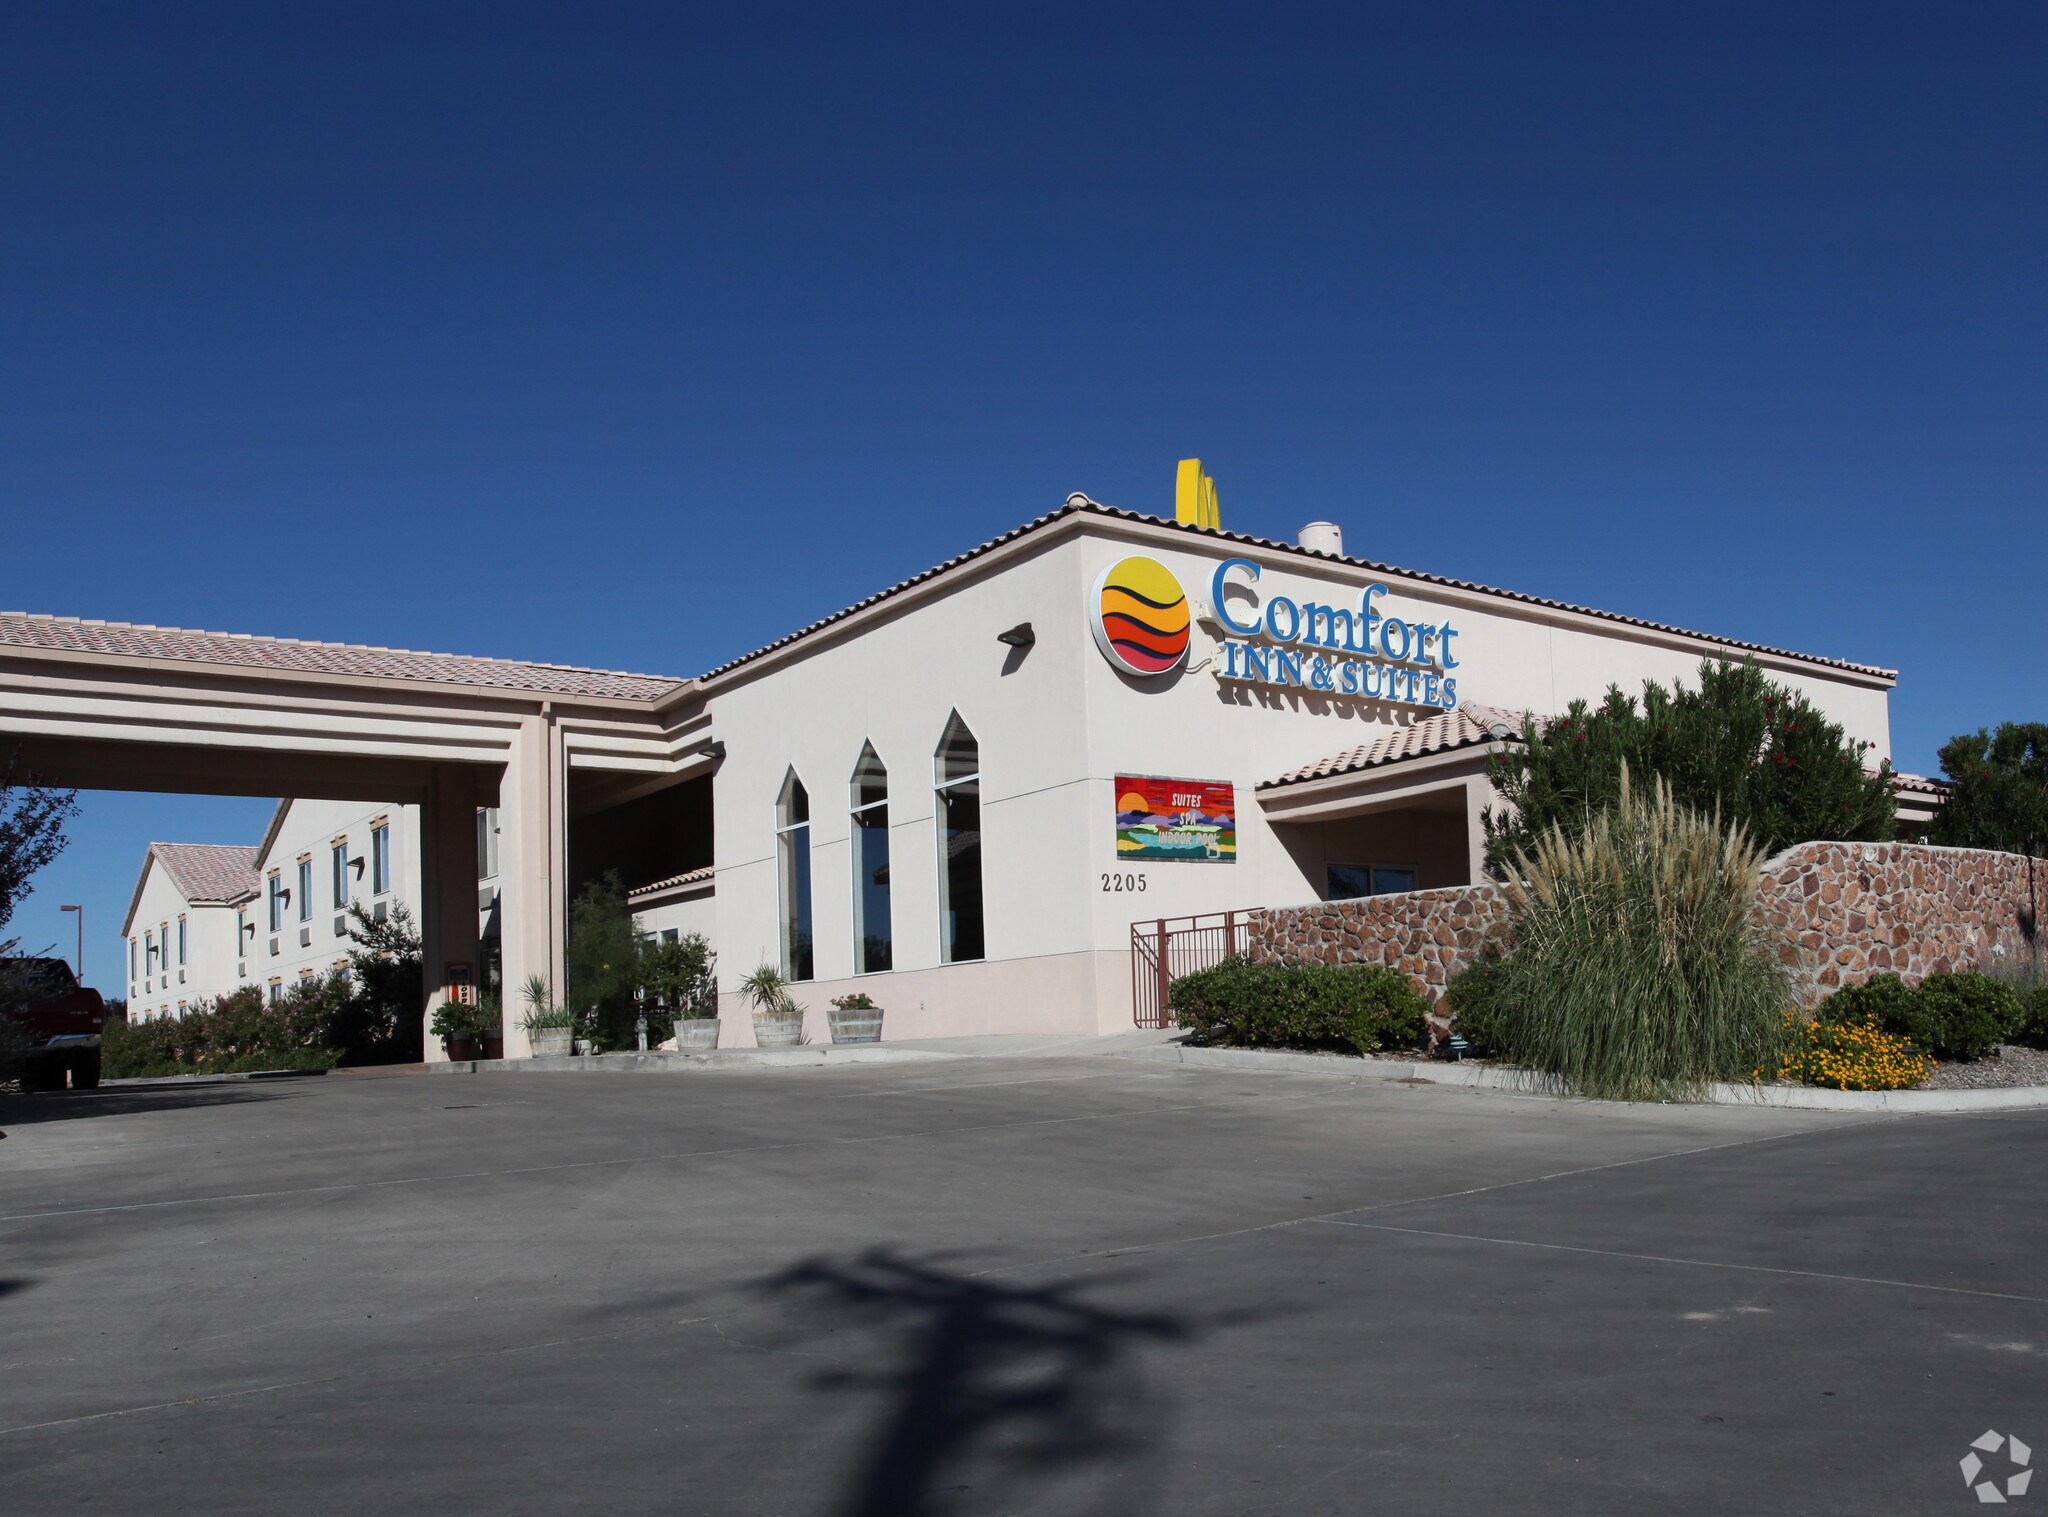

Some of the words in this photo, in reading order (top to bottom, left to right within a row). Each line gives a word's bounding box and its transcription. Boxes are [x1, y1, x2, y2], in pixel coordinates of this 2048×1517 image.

[1211, 558, 1460, 670] Comfort
[1223, 641, 1302, 687] INN
[1311, 656, 1335, 690] &
[1342, 661, 1457, 710] SUITES
[1171, 793, 1202, 808] SUITES
[1179, 813, 1196, 825] SPA
[1158, 831, 1192, 845] INDOOR
[1196, 832, 1217, 846] POOL
[1101, 873, 1147, 892] 2205
